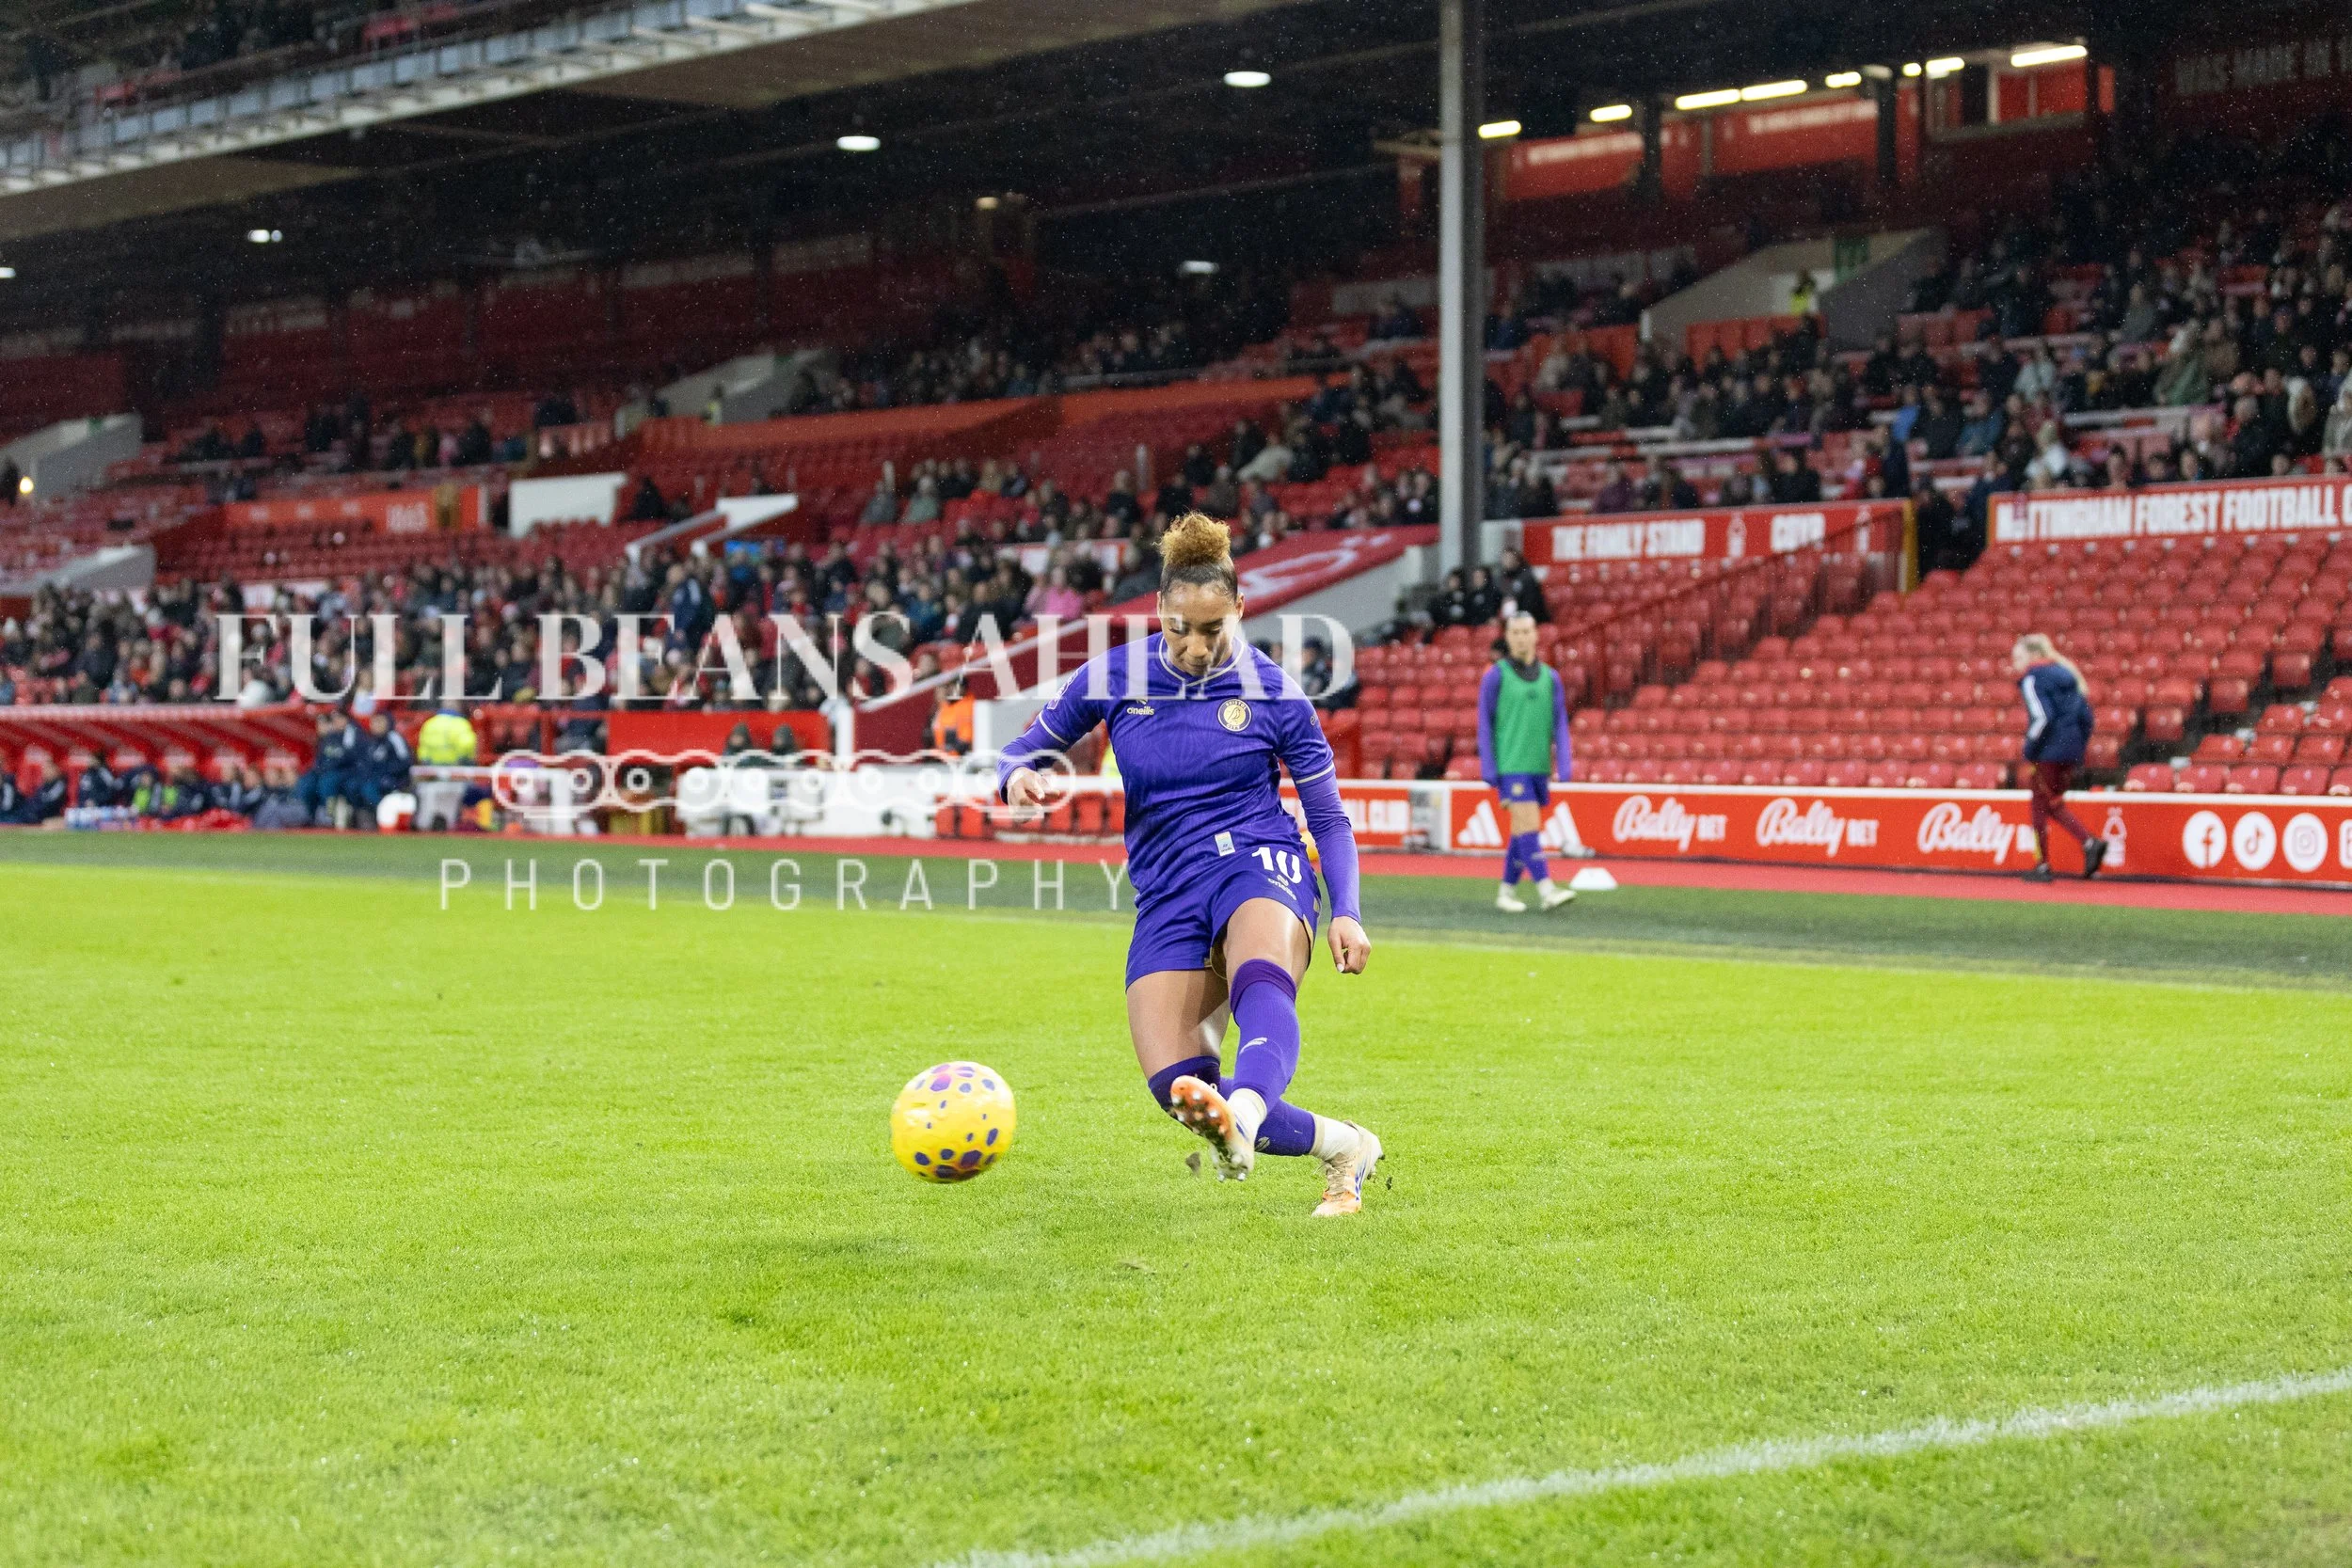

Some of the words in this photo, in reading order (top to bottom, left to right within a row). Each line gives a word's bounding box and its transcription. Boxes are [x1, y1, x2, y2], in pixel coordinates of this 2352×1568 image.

[2135, 491, 2222, 535] FOREST
[2222, 483, 2338, 531] FOOTBALL
[1552, 525, 1584, 562] THE
[1585, 522, 1645, 559] FAMILY
[1645, 518, 1705, 557] STAND
[1612, 794, 1696, 852] Bally
[1755, 797, 1847, 858] Bally
[1916, 801, 2015, 865] Bally
[1251, 847, 1302, 884] 10
